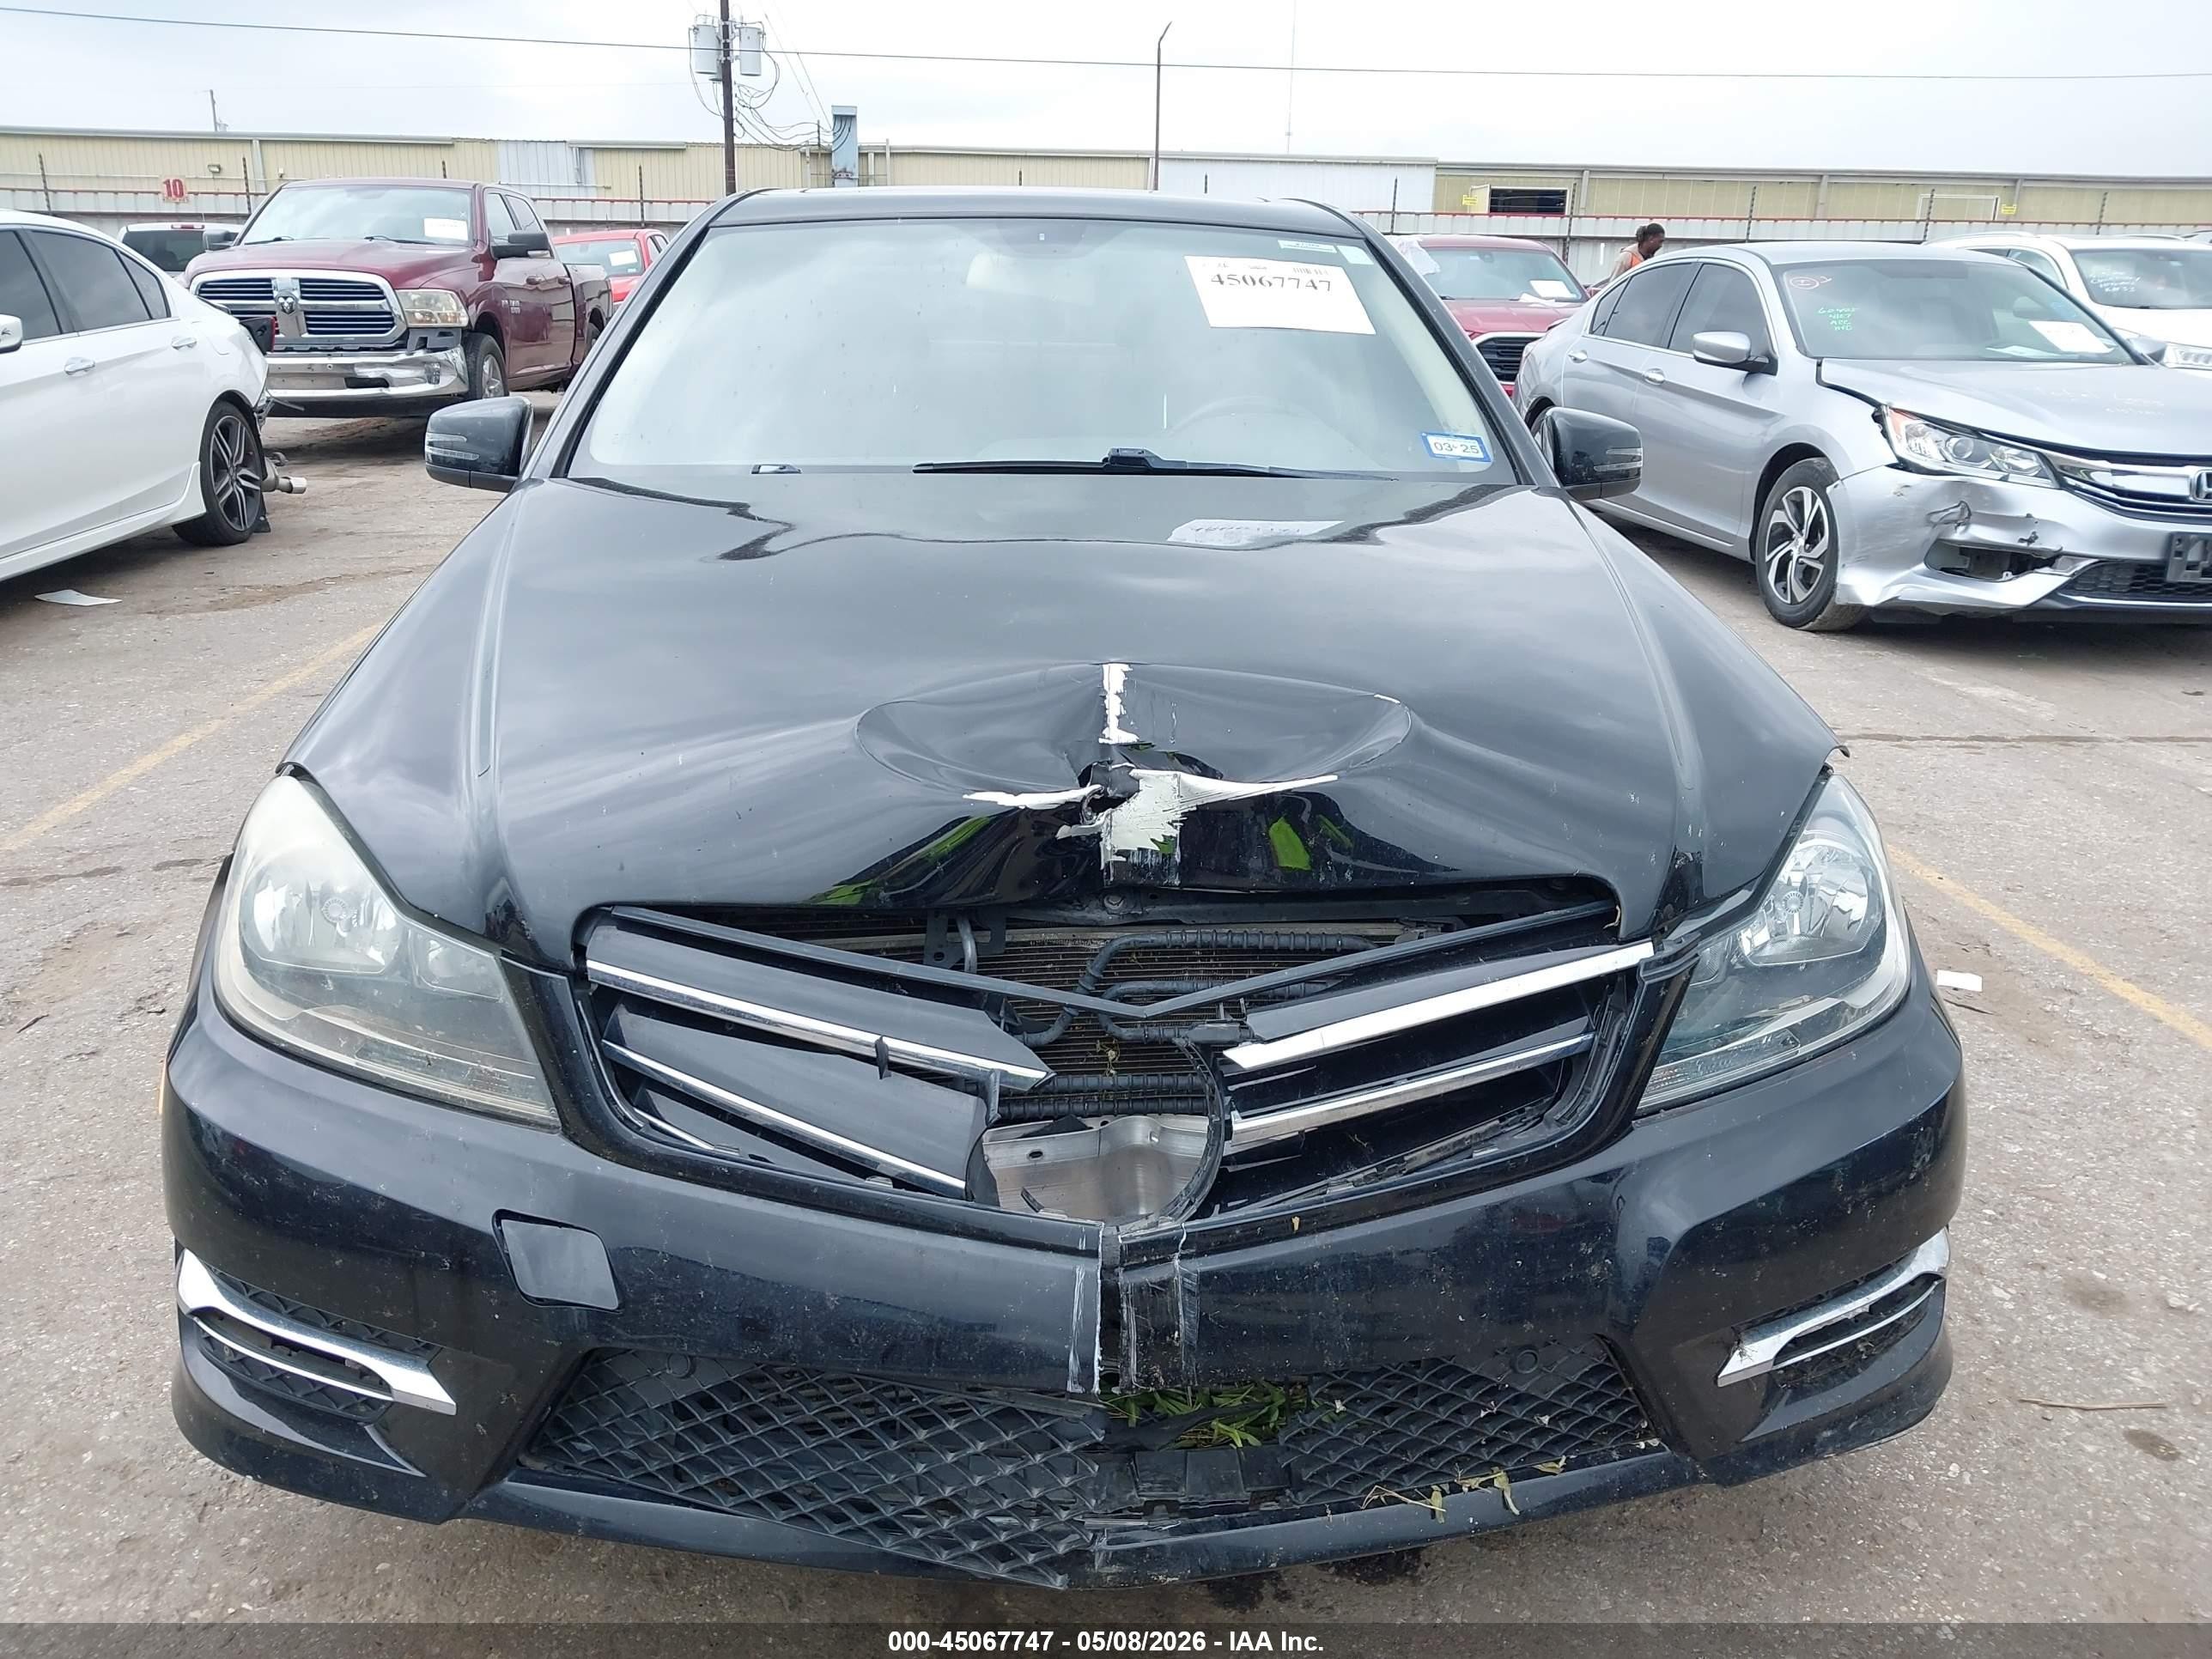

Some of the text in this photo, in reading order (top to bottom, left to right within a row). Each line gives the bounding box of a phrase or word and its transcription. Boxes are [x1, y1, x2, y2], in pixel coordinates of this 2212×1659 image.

[163, 179, 184, 198] 10
[1211, 272, 1331, 292] 45067747
[1433, 441, 1480, 454] 03 25
